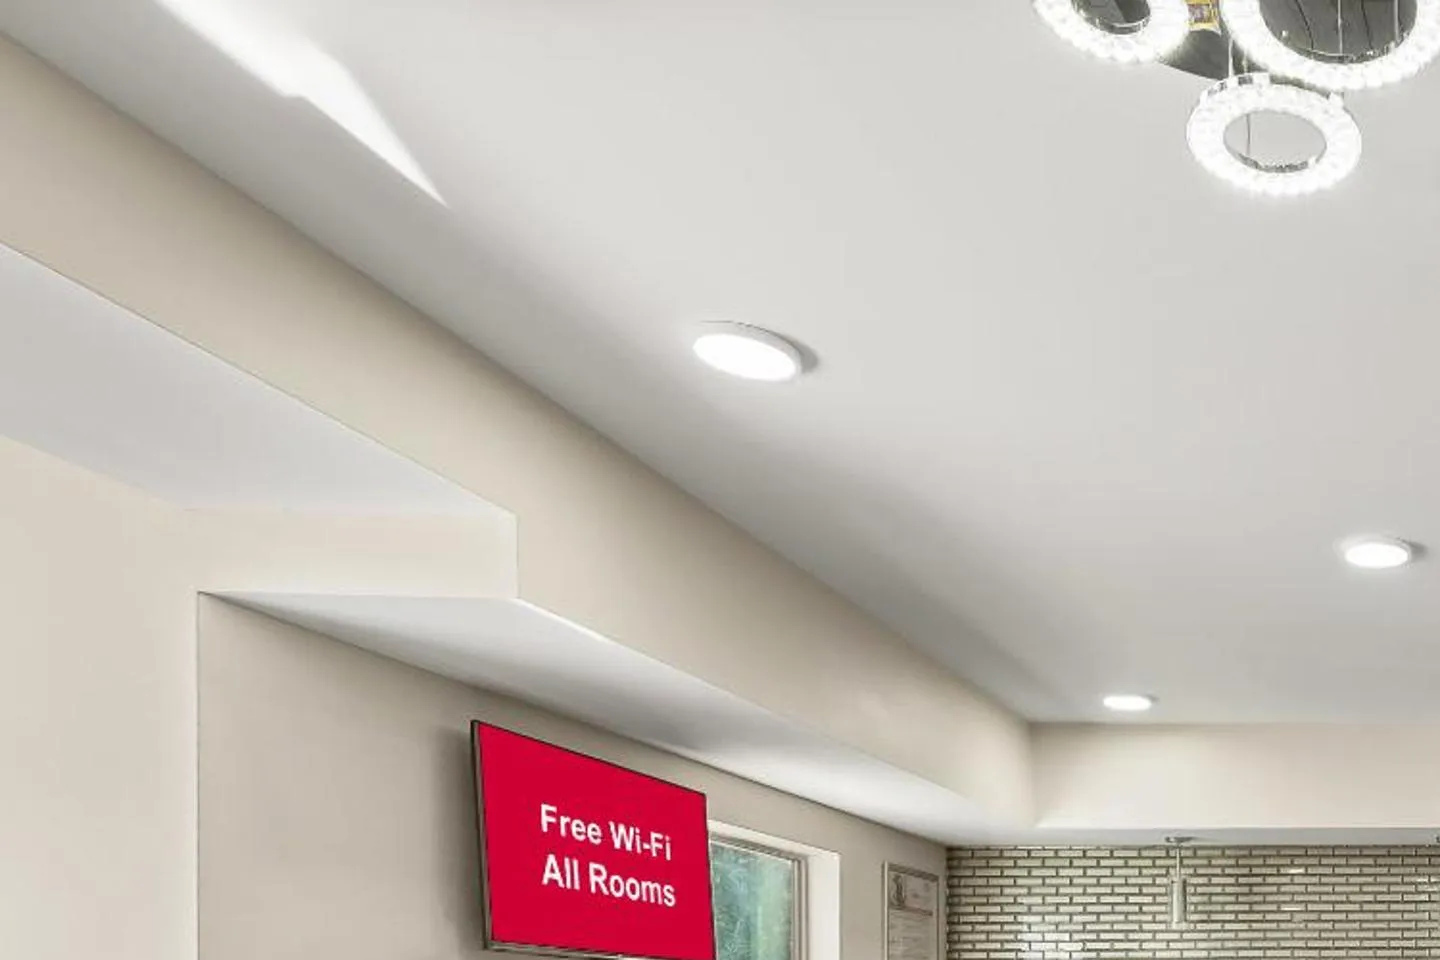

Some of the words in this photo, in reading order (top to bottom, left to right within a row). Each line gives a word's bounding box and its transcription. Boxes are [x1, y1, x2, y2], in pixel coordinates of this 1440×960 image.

[541, 803, 602, 845] Free
[608, 820, 671, 861] Wi-Fi
[542, 853, 580, 890] All
[589, 861, 676, 907] Rooms
